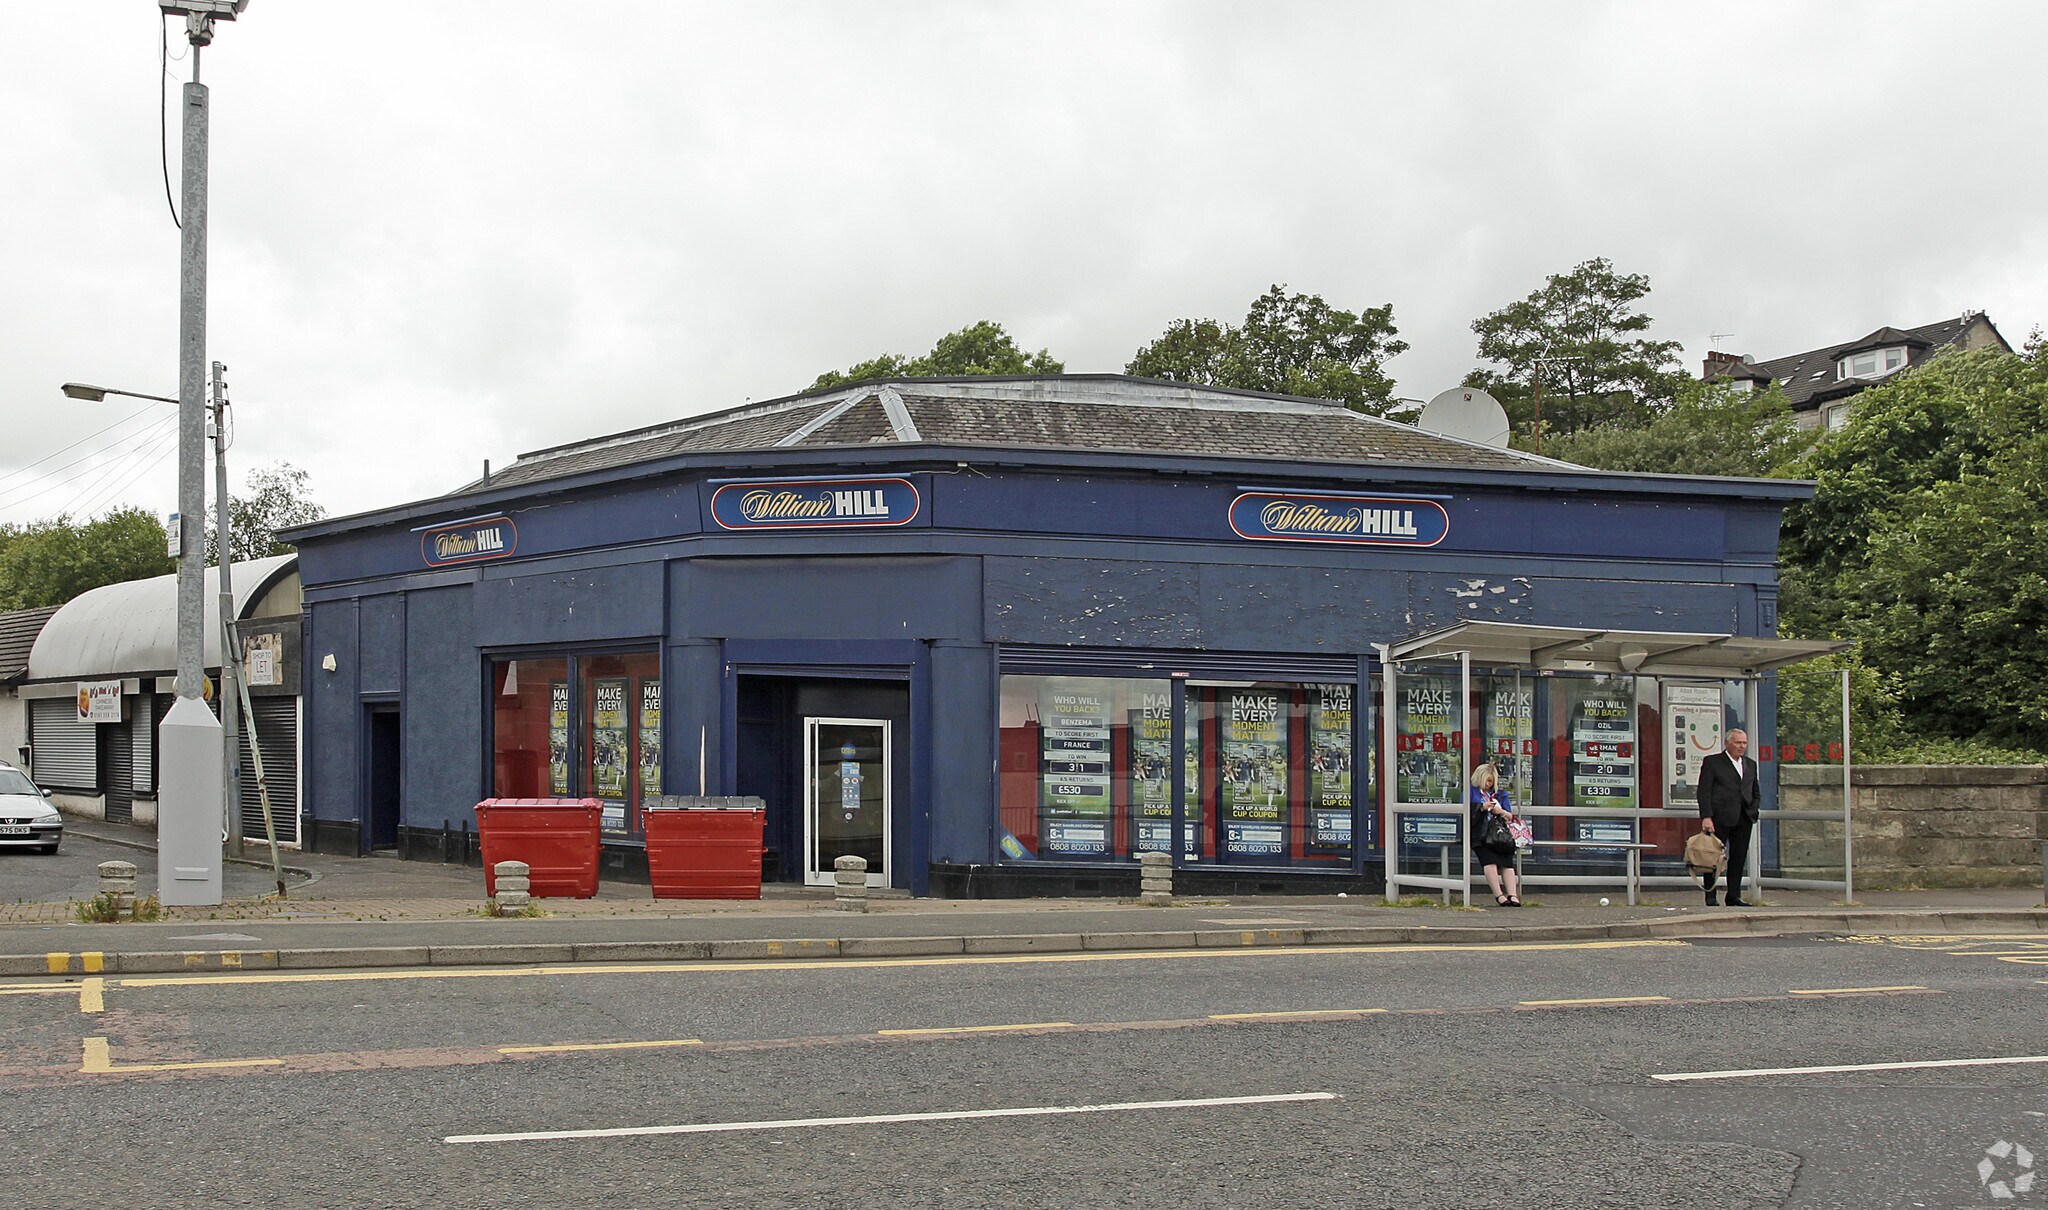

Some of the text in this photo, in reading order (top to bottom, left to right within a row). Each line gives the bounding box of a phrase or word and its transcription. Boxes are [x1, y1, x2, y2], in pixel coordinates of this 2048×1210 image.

[740, 490, 889, 520] William HILL
[1260, 500, 1417, 535] William HILL
[435, 528, 503, 558] William HILL
[256, 661, 267, 672] LET
[554, 688, 568, 700] MA
[598, 688, 622, 700] MAKE
[1408, 689, 1452, 703] MAKE
[554, 700, 568, 711] EVE
[598, 700, 622, 711] EVERY
[644, 699, 660, 710] EVE
[1054, 696, 1100, 705] WHO WILL
[1232, 696, 1277, 710] MAKE
[1321, 700, 1351, 710] EVE
[1583, 700, 1627, 709] WHO WILL
[1143, 707, 1170, 719] EVE
[1408, 703, 1452, 715] EVERY
[598, 711, 622, 720] MOMENT
[1232, 710, 1277, 722] EVERY
[1408, 715, 1451, 724] MOMENT
[1232, 721, 1277, 730] MOMENT
[1058, 786, 1081, 794] £530
